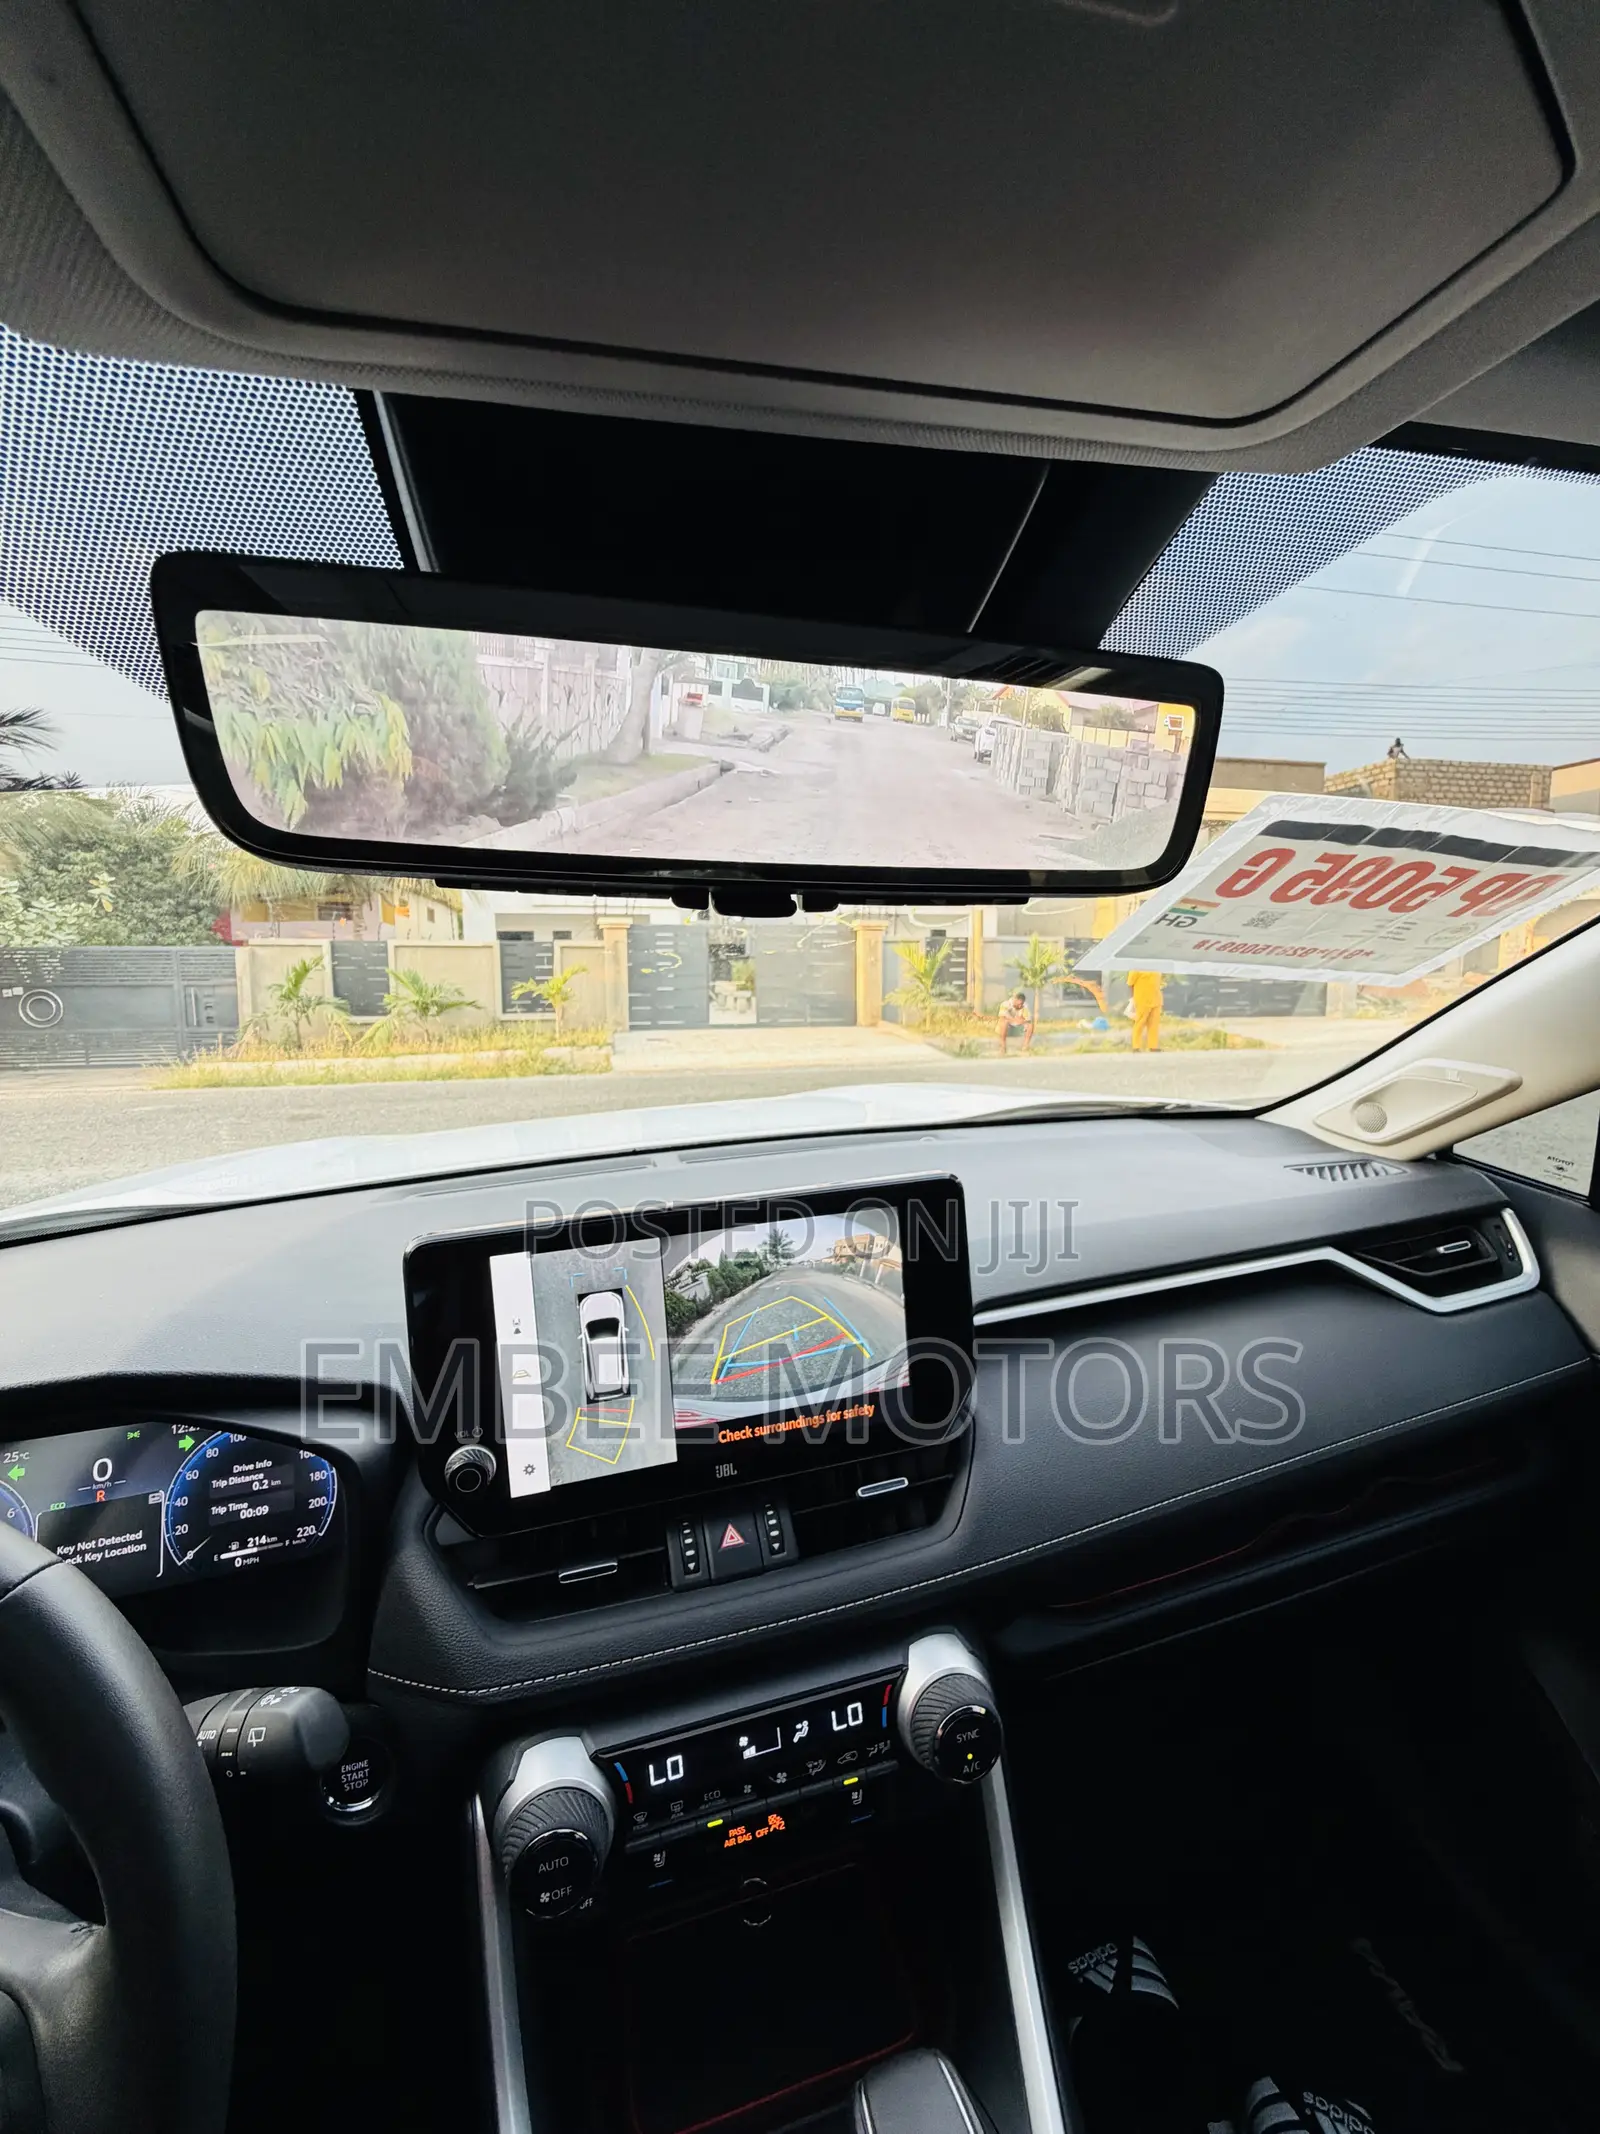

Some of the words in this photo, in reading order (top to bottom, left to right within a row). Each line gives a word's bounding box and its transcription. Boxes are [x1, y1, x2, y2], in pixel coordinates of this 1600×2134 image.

[718, 1425, 753, 1444] Check
[753, 1414, 825, 1437] surroundings
[825, 1409, 843, 1423] for
[843, 1403, 875, 1421] safety
[205, 1447, 219, 1459] 80
[92, 1458, 113, 1482] 0
[232, 1464, 255, 1474] Drive
[255, 1459, 273, 1469] Info
[715, 1462, 738, 1479] JBL
[185, 1470, 199, 1481] 60
[211, 1479, 228, 1489] Trip
[228, 1473, 265, 1485] Distance
[309, 1470, 327, 1482] 180
[92, 1481, 112, 1491] km/h
[252, 1479, 269, 1491] 0.2
[95, 1489, 106, 1503] R
[174, 1496, 189, 1507] 40
[308, 1497, 326, 1509] 200
[7, 1508, 15, 1518] 6
[50, 1502, 66, 1511] ECO
[211, 1506, 227, 1515] Trip
[227, 1502, 249, 1512] Time
[240, 1505, 269, 1519] 00:09
[175, 1524, 189, 1535] 20
[296, 1525, 316, 1538] 220
[56, 1545, 76, 1555] Key
[77, 1540, 96, 1552] Not
[97, 1530, 143, 1547] Detected
[247, 1535, 267, 1548] 214
[84, 1552, 103, 1563] Key
[104, 1543, 147, 1558] Location
[213, 1554, 219, 1562] E
[234, 1557, 243, 1568] 0
[242, 1556, 260, 1566] MPH
[831, 1702, 863, 1732] LO
[196, 1729, 216, 1740] AUTO
[956, 1728, 980, 1744] SYNC
[341, 1759, 369, 1773] ENGINE
[648, 1754, 684, 1787] LO
[963, 1761, 981, 1775] A/C
[341, 1768, 370, 1784] START
[344, 1778, 369, 1792] STOP
[703, 1790, 721, 1801] ECO
[724, 1838, 736, 1849] AIR
[737, 1833, 753, 1844] BAG
[755, 1827, 769, 1838] OFF
[728, 1826, 746, 1838] PASS
[538, 1856, 569, 1874] AUTO
[551, 1885, 572, 1900] OFF
[1067, 1943, 1118, 1975] adidas
